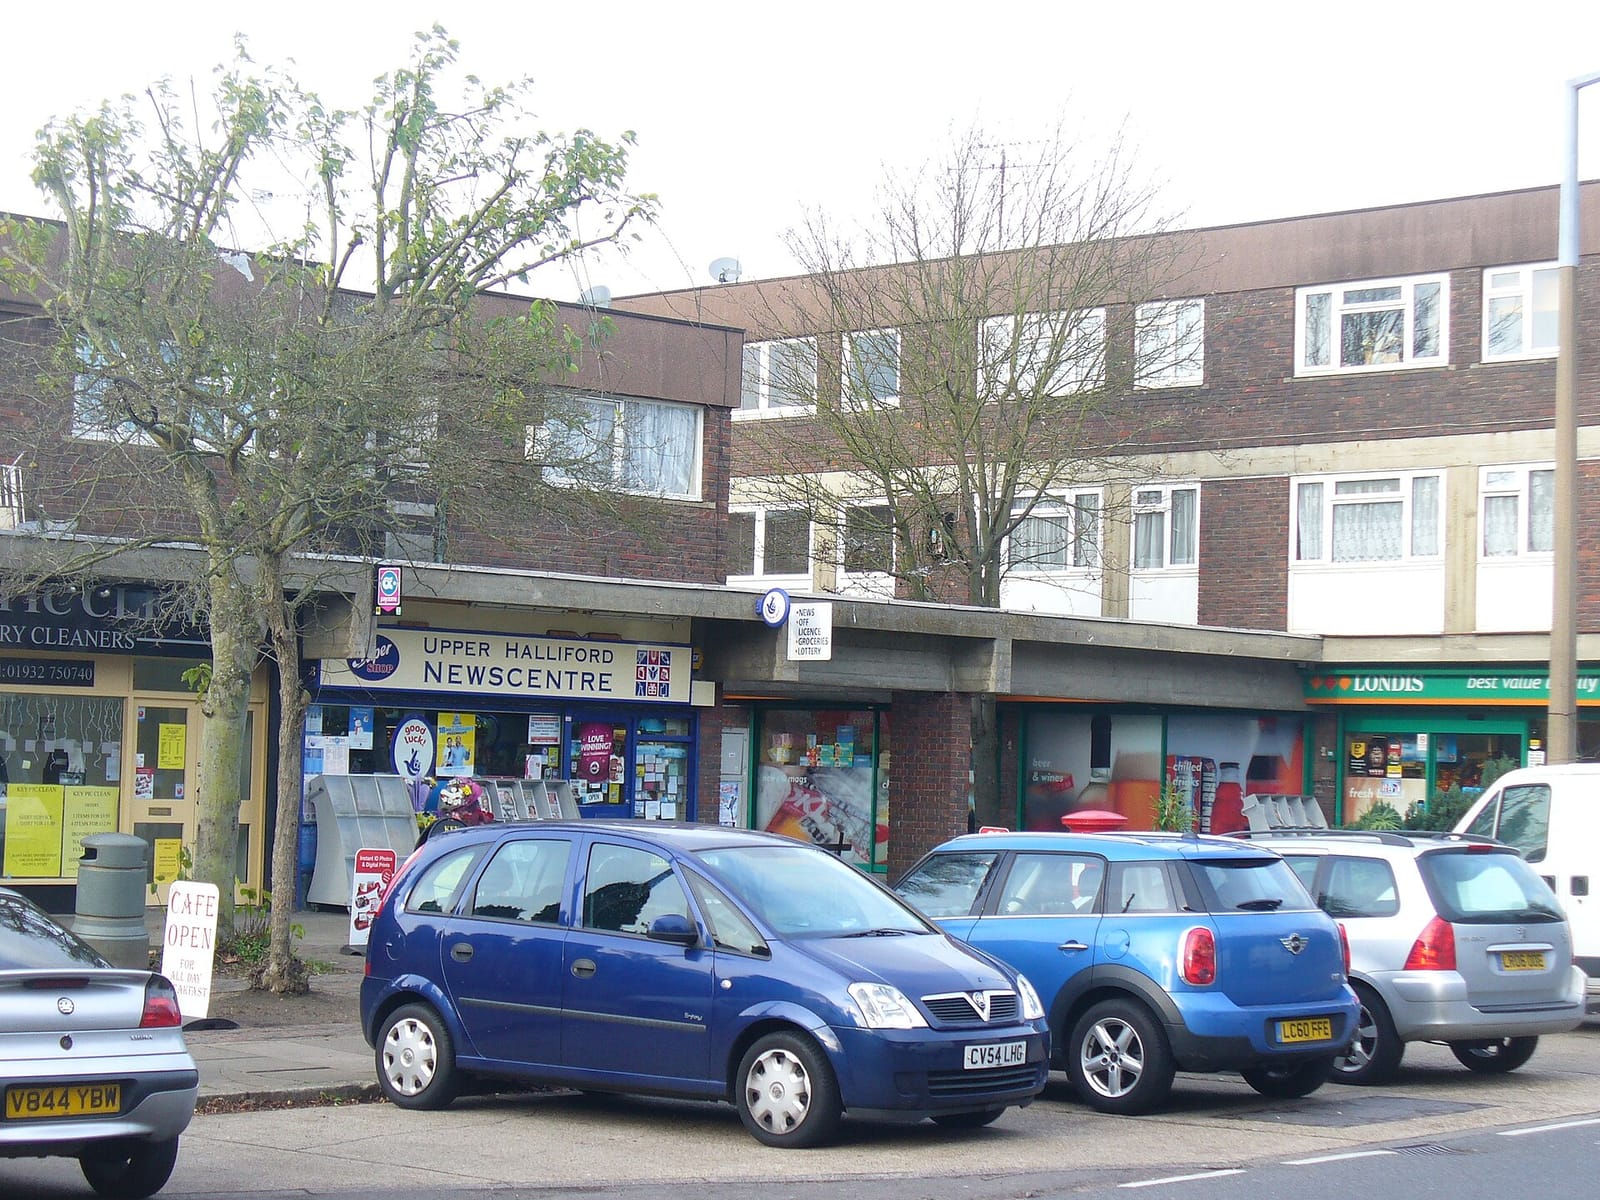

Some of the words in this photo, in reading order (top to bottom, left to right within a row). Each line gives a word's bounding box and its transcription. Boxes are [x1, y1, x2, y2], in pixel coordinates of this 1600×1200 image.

[798, 618, 809, 626] OFF
[798, 627, 821, 636] LICENCE
[31, 627, 135, 649] CLEANERS
[798, 637, 829, 645] GROCERIES
[424, 637, 490, 657] UPPER
[505, 642, 614, 664] HALLIFORD
[798, 647, 821, 655] LOTTERY
[49, 666, 93, 681] 750740
[367, 663, 393, 674] SHOP
[424, 661, 613, 692] NEWSCENTRE
[1353, 677, 1424, 692] LONDIS
[1467, 677, 1498, 689] best
[1502, 677, 1541, 690] value
[405, 725, 427, 736] good
[404, 735, 426, 747] luck!
[587, 734, 605, 743] LOVE
[581, 742, 612, 751] WINNING?
[1172, 761, 1203, 771] chilled
[788, 775, 808, 785] mags
[1041, 773, 1064, 782] wines
[588, 793, 600, 801] OPEN
[1349, 788, 1373, 798] fresh
[171, 890, 215, 917] CAFE
[168, 923, 212, 950] OPEN
[180, 958, 194, 970] FOR
[170, 970, 184, 982] ALL
[187, 972, 202, 984] DAY
[1282, 1022, 1310, 1039] LC60
[1311, 1020, 1329, 1037] FFE
[970, 1046, 1002, 1065] CV54
[1004, 1044, 1023, 1062] LHG
[10, 1089, 70, 1113] V844
[77, 1087, 118, 1109] YBW
